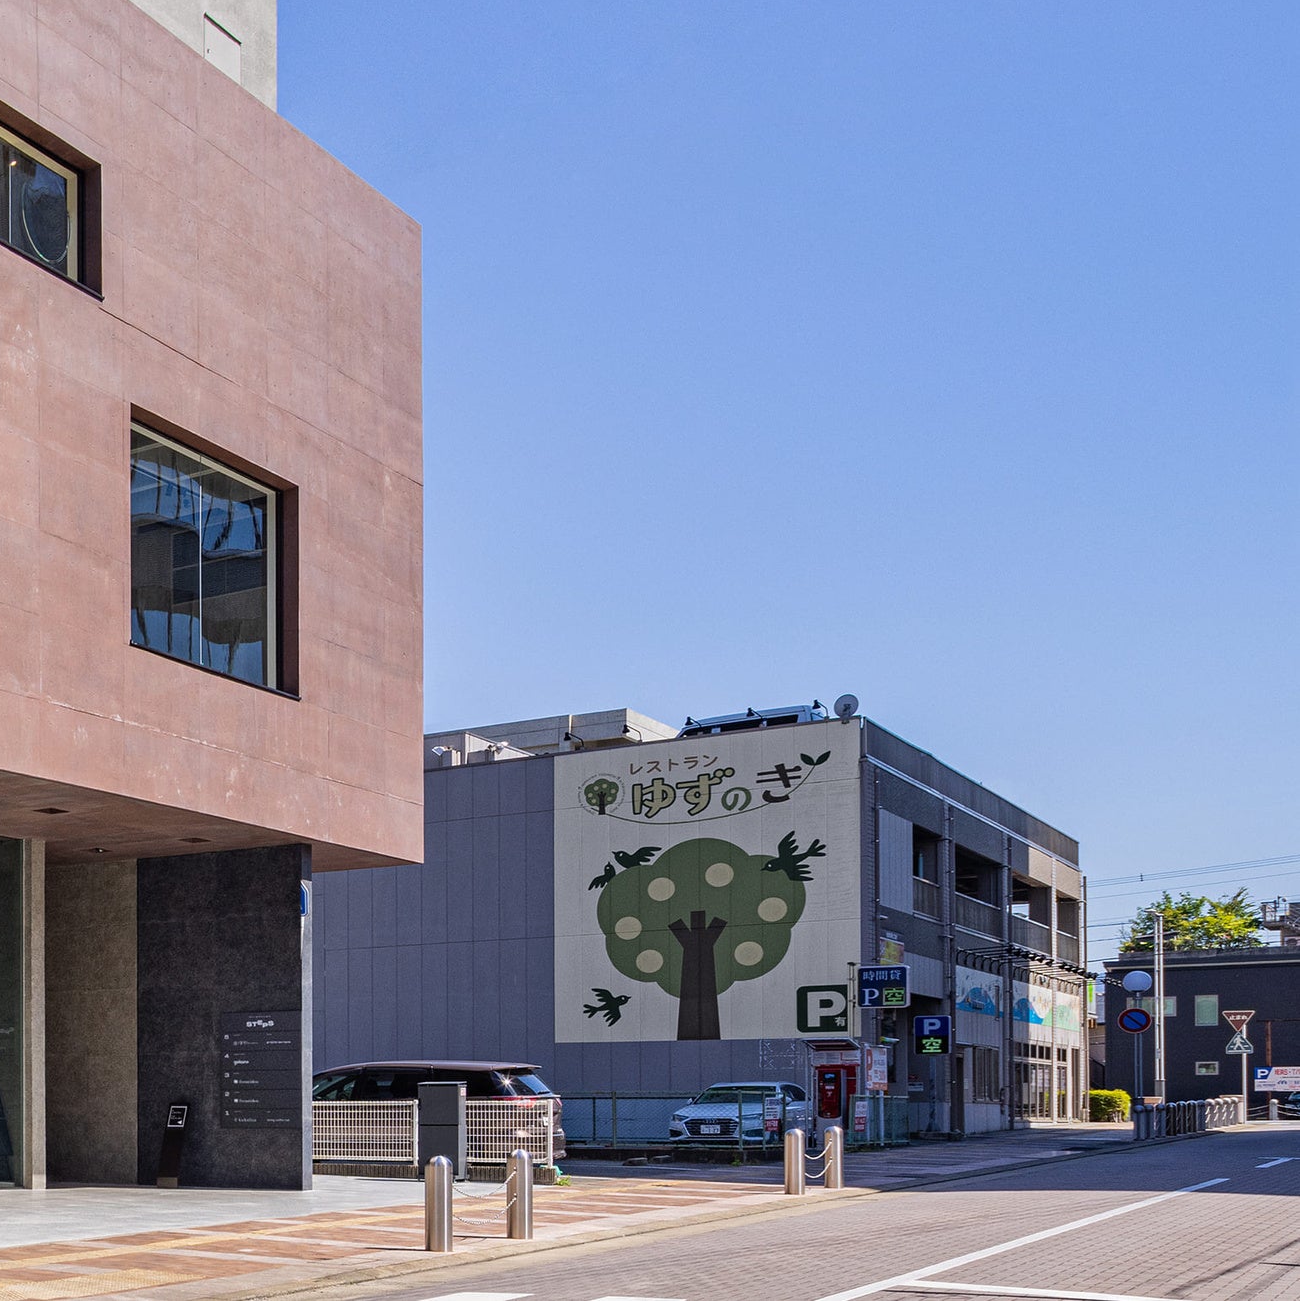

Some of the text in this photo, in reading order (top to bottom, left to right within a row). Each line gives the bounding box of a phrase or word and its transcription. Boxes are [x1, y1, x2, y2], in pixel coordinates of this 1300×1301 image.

[629, 754, 718, 775] レストラン
[631, 763, 803, 819] ゆずのき
[862, 969, 902, 981] 時間貸
[862, 988, 905, 1006] P 空
[806, 990, 846, 1028] P
[923, 1018, 941, 1035] P
[921, 1037, 942, 1053] 空
[1257, 1069, 1269, 1078] P
